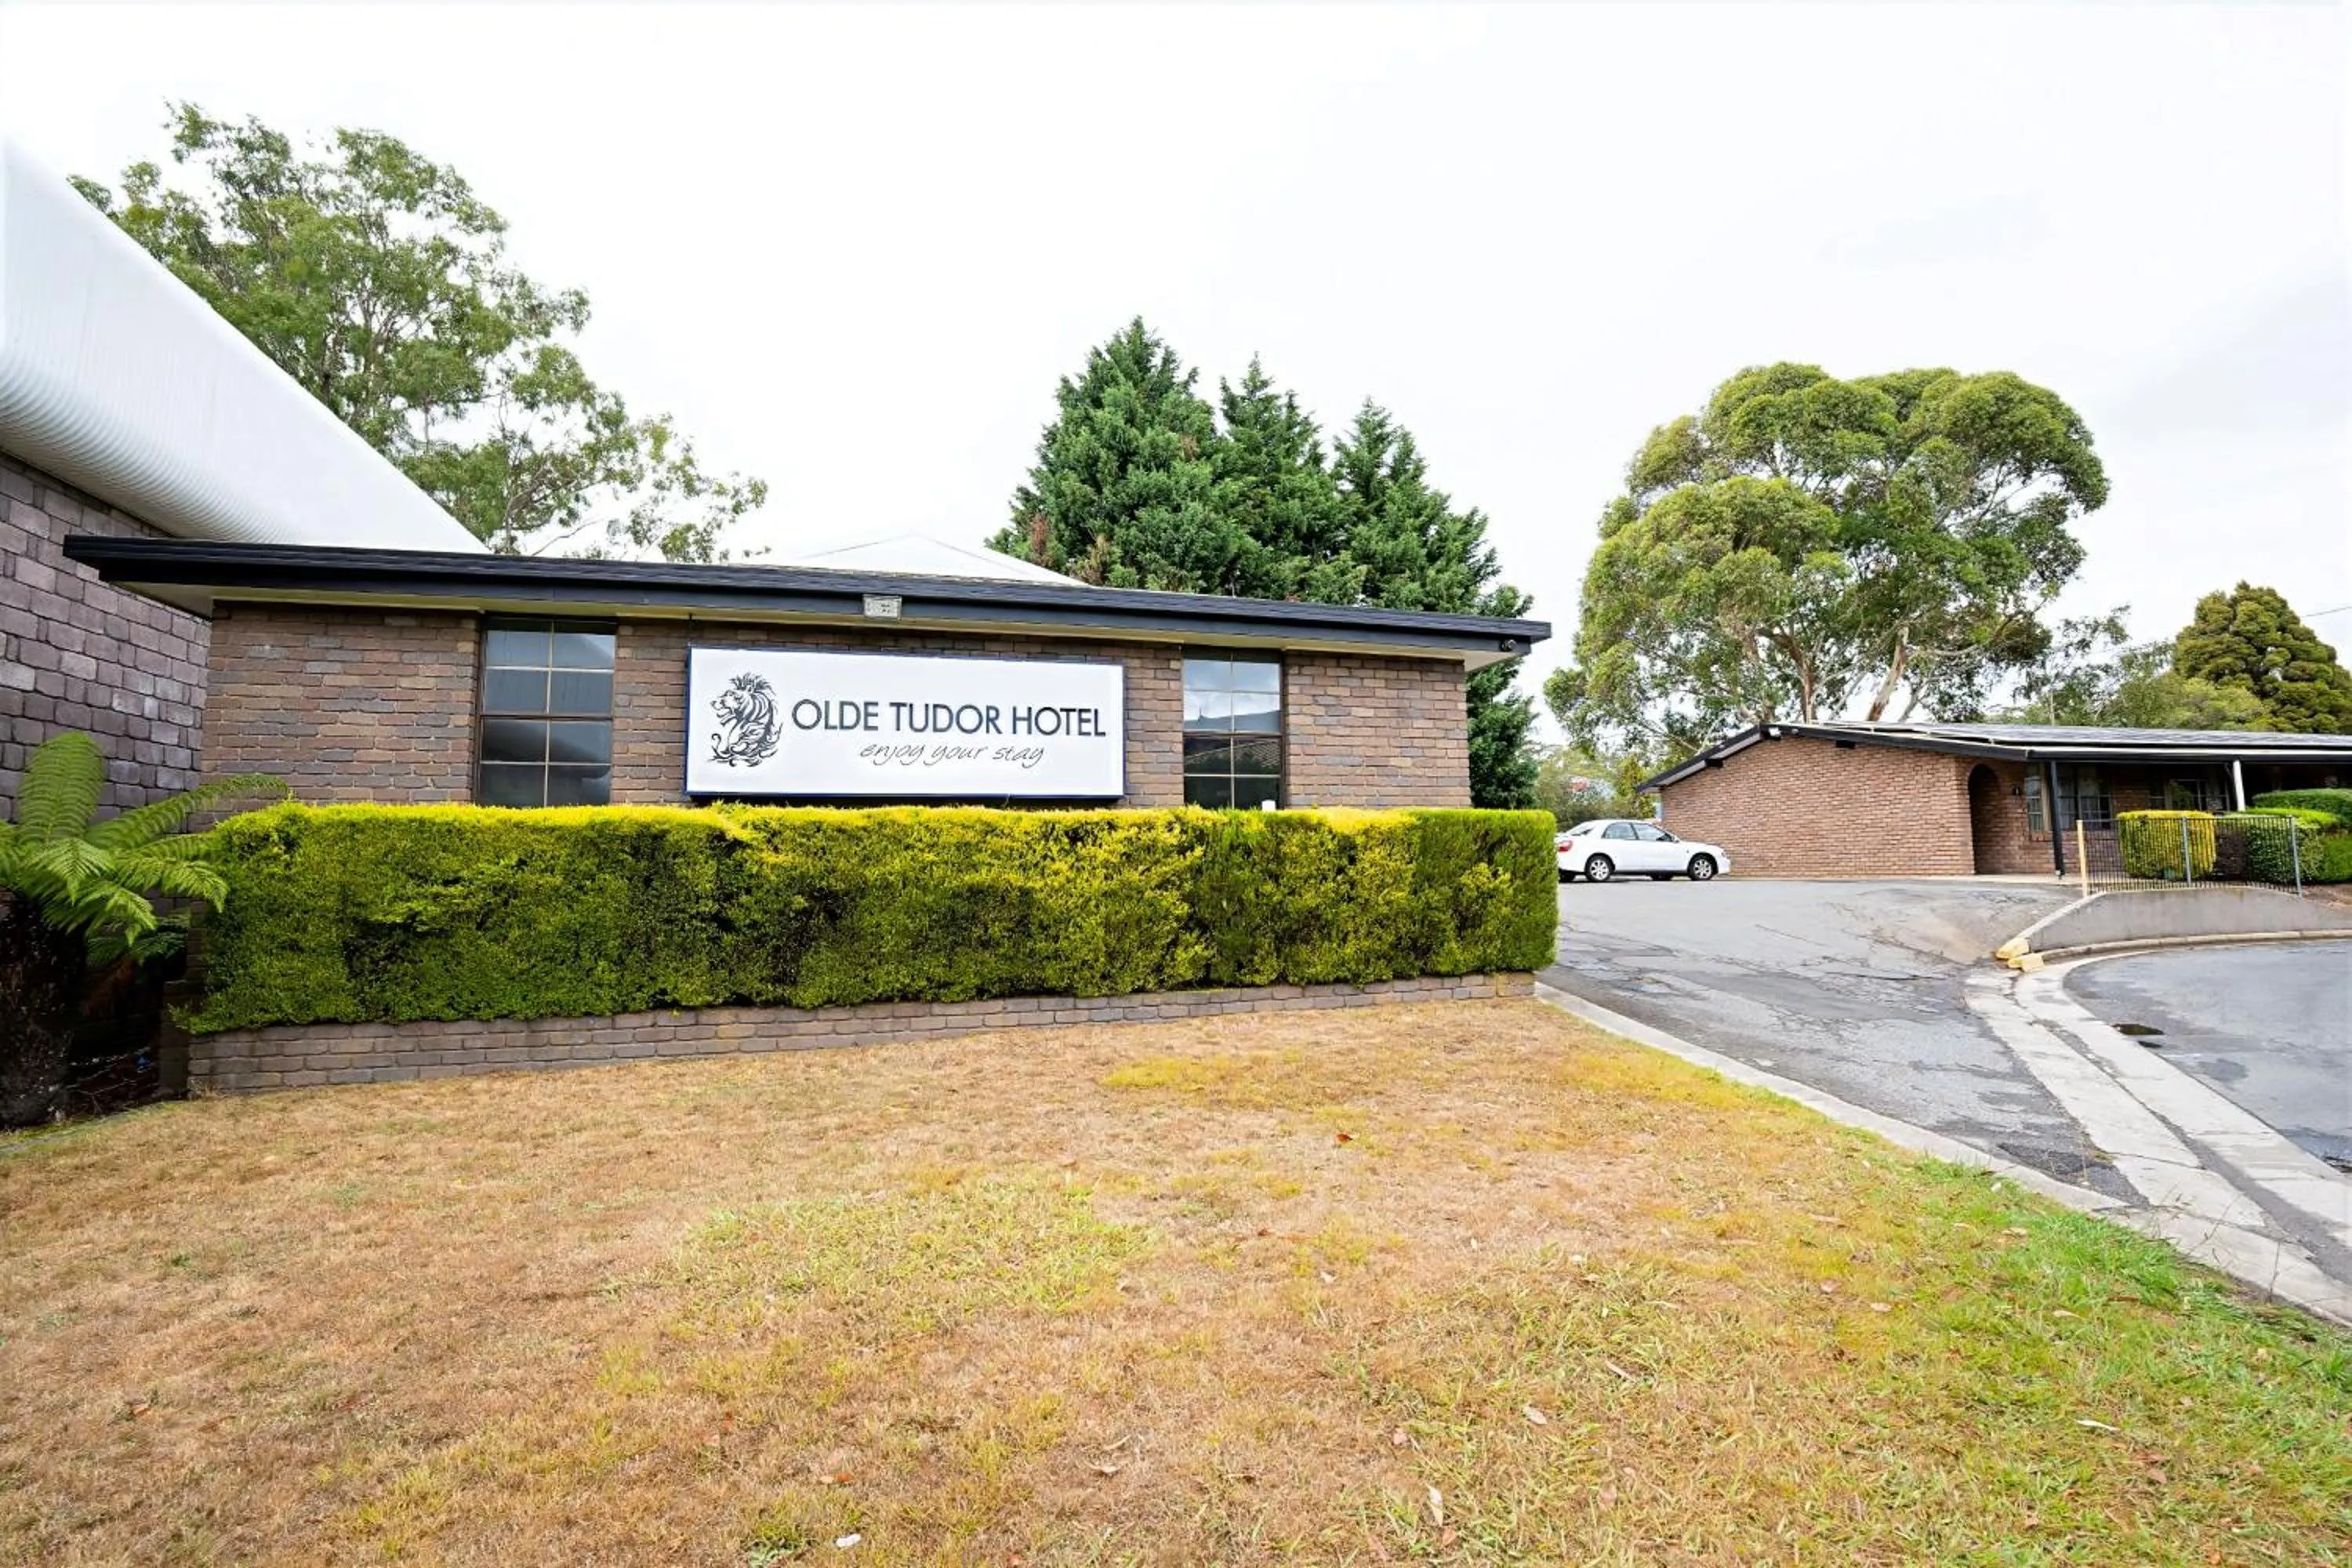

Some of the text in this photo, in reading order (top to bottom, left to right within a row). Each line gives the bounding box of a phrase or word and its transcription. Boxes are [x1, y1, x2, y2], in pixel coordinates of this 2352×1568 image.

[791, 699, 1106, 737] OLDE TUDOR HOTEL
[860, 743, 1044, 768] enjoy your stay
